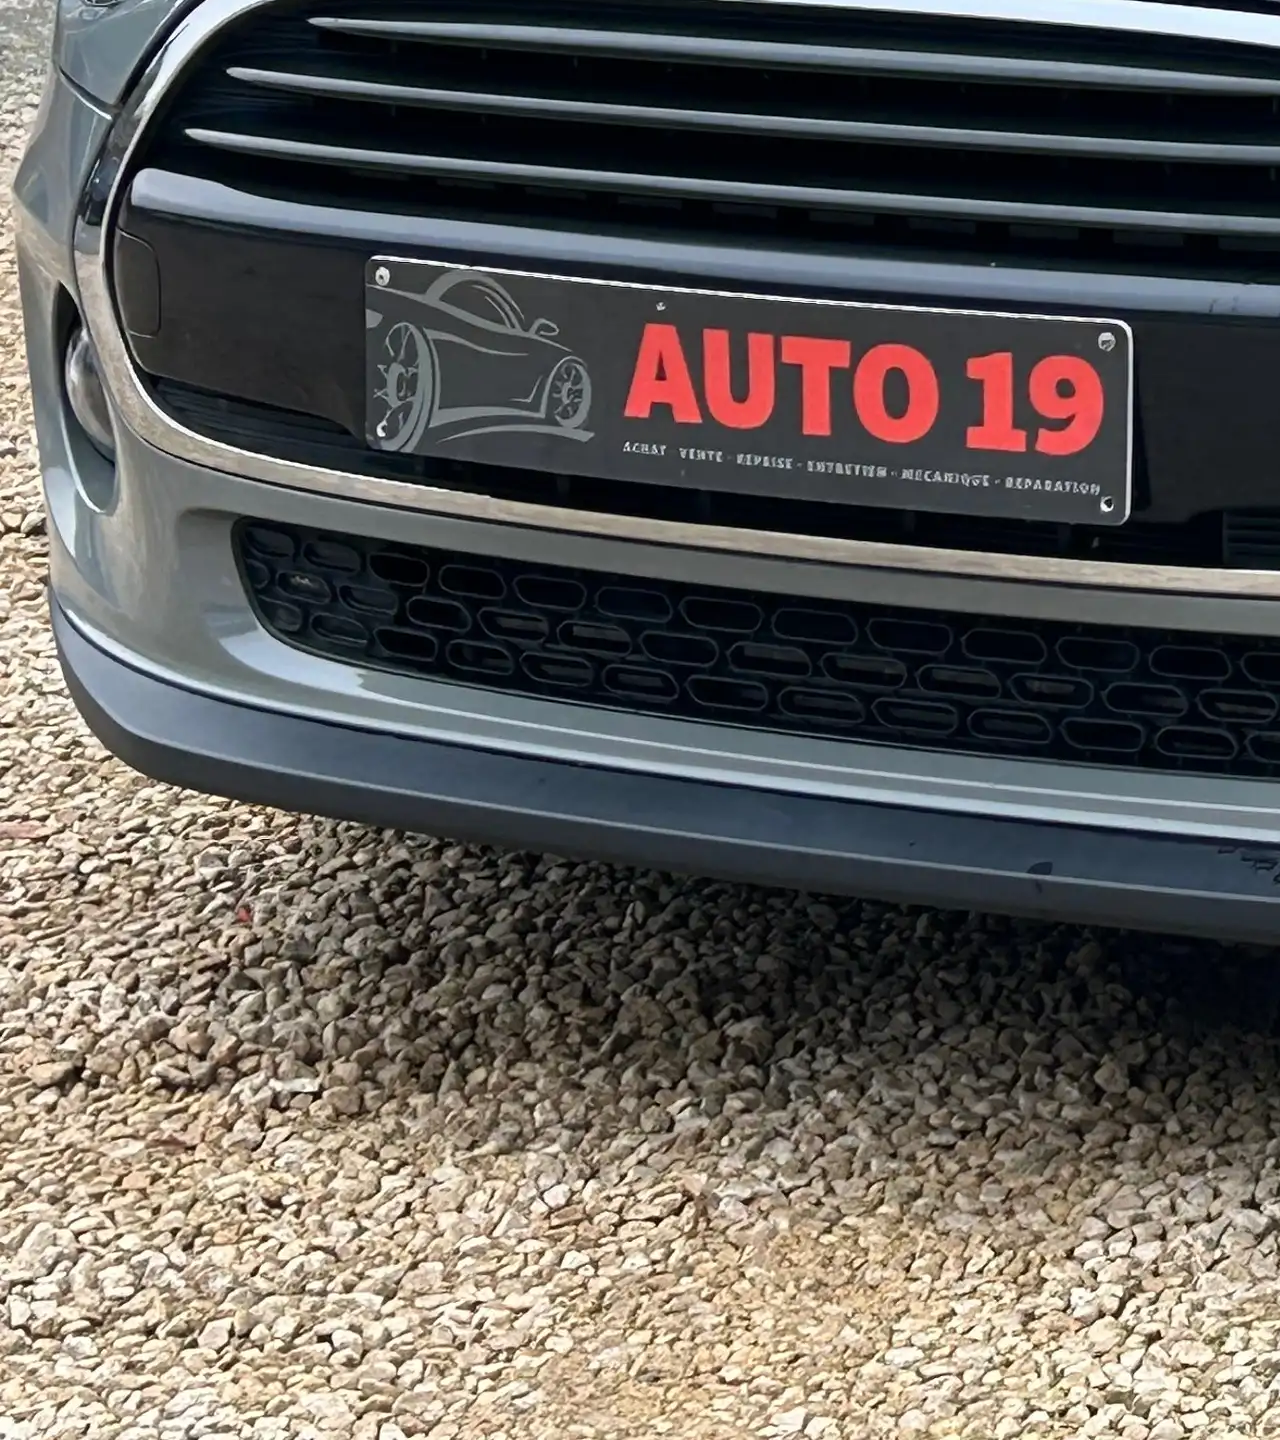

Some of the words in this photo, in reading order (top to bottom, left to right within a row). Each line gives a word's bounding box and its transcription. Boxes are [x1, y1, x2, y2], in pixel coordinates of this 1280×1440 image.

[624, 323, 939, 444] AUTO
[965, 351, 1104, 457] 19
[622, 440, 667, 457] ACHAT
[679, 447, 723, 463] VENTE
[736, 453, 793, 470] REPRISE
